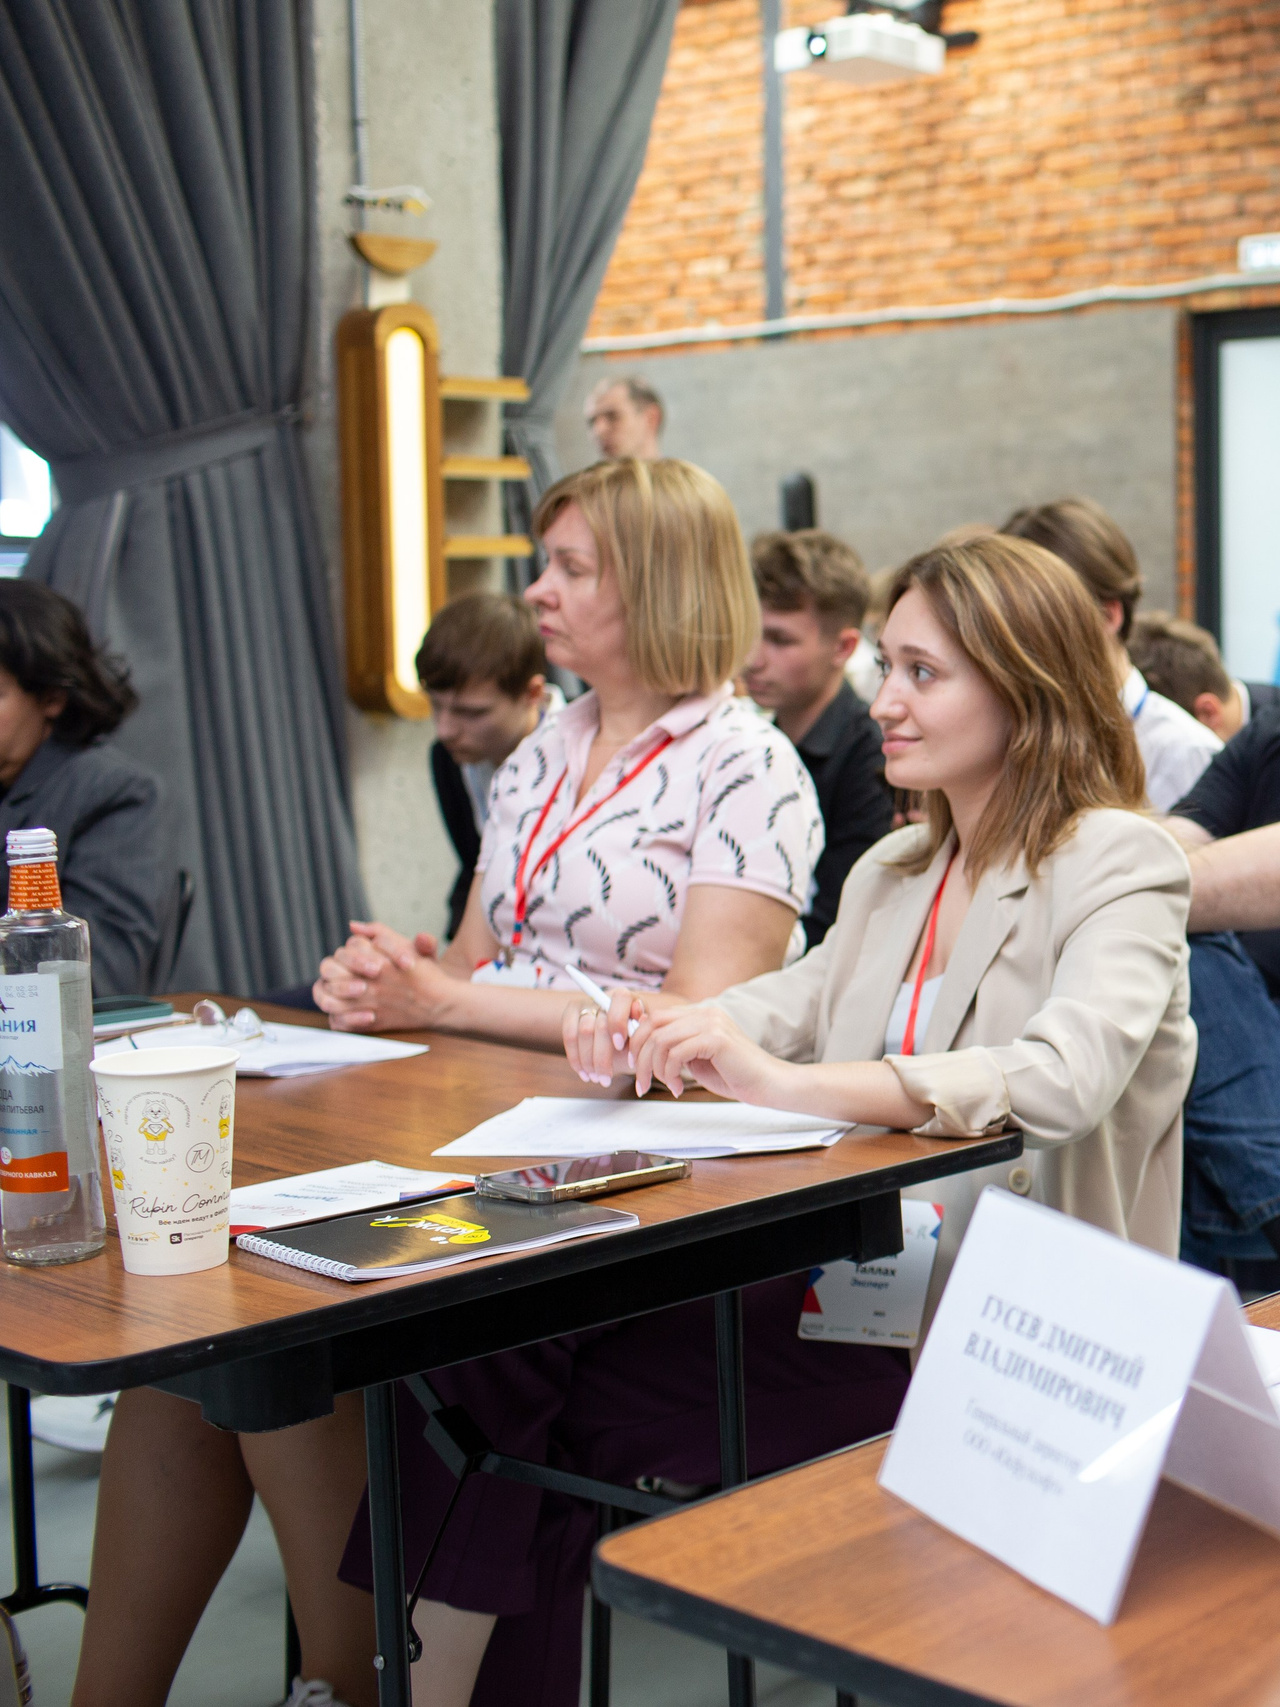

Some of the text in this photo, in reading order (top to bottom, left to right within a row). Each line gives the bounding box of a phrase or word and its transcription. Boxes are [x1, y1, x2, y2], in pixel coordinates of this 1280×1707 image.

[0, 1019, 37, 1033] НИЯ
[980, 1293, 1146, 1390] ГУСЕВ ДМИТРИЙ
